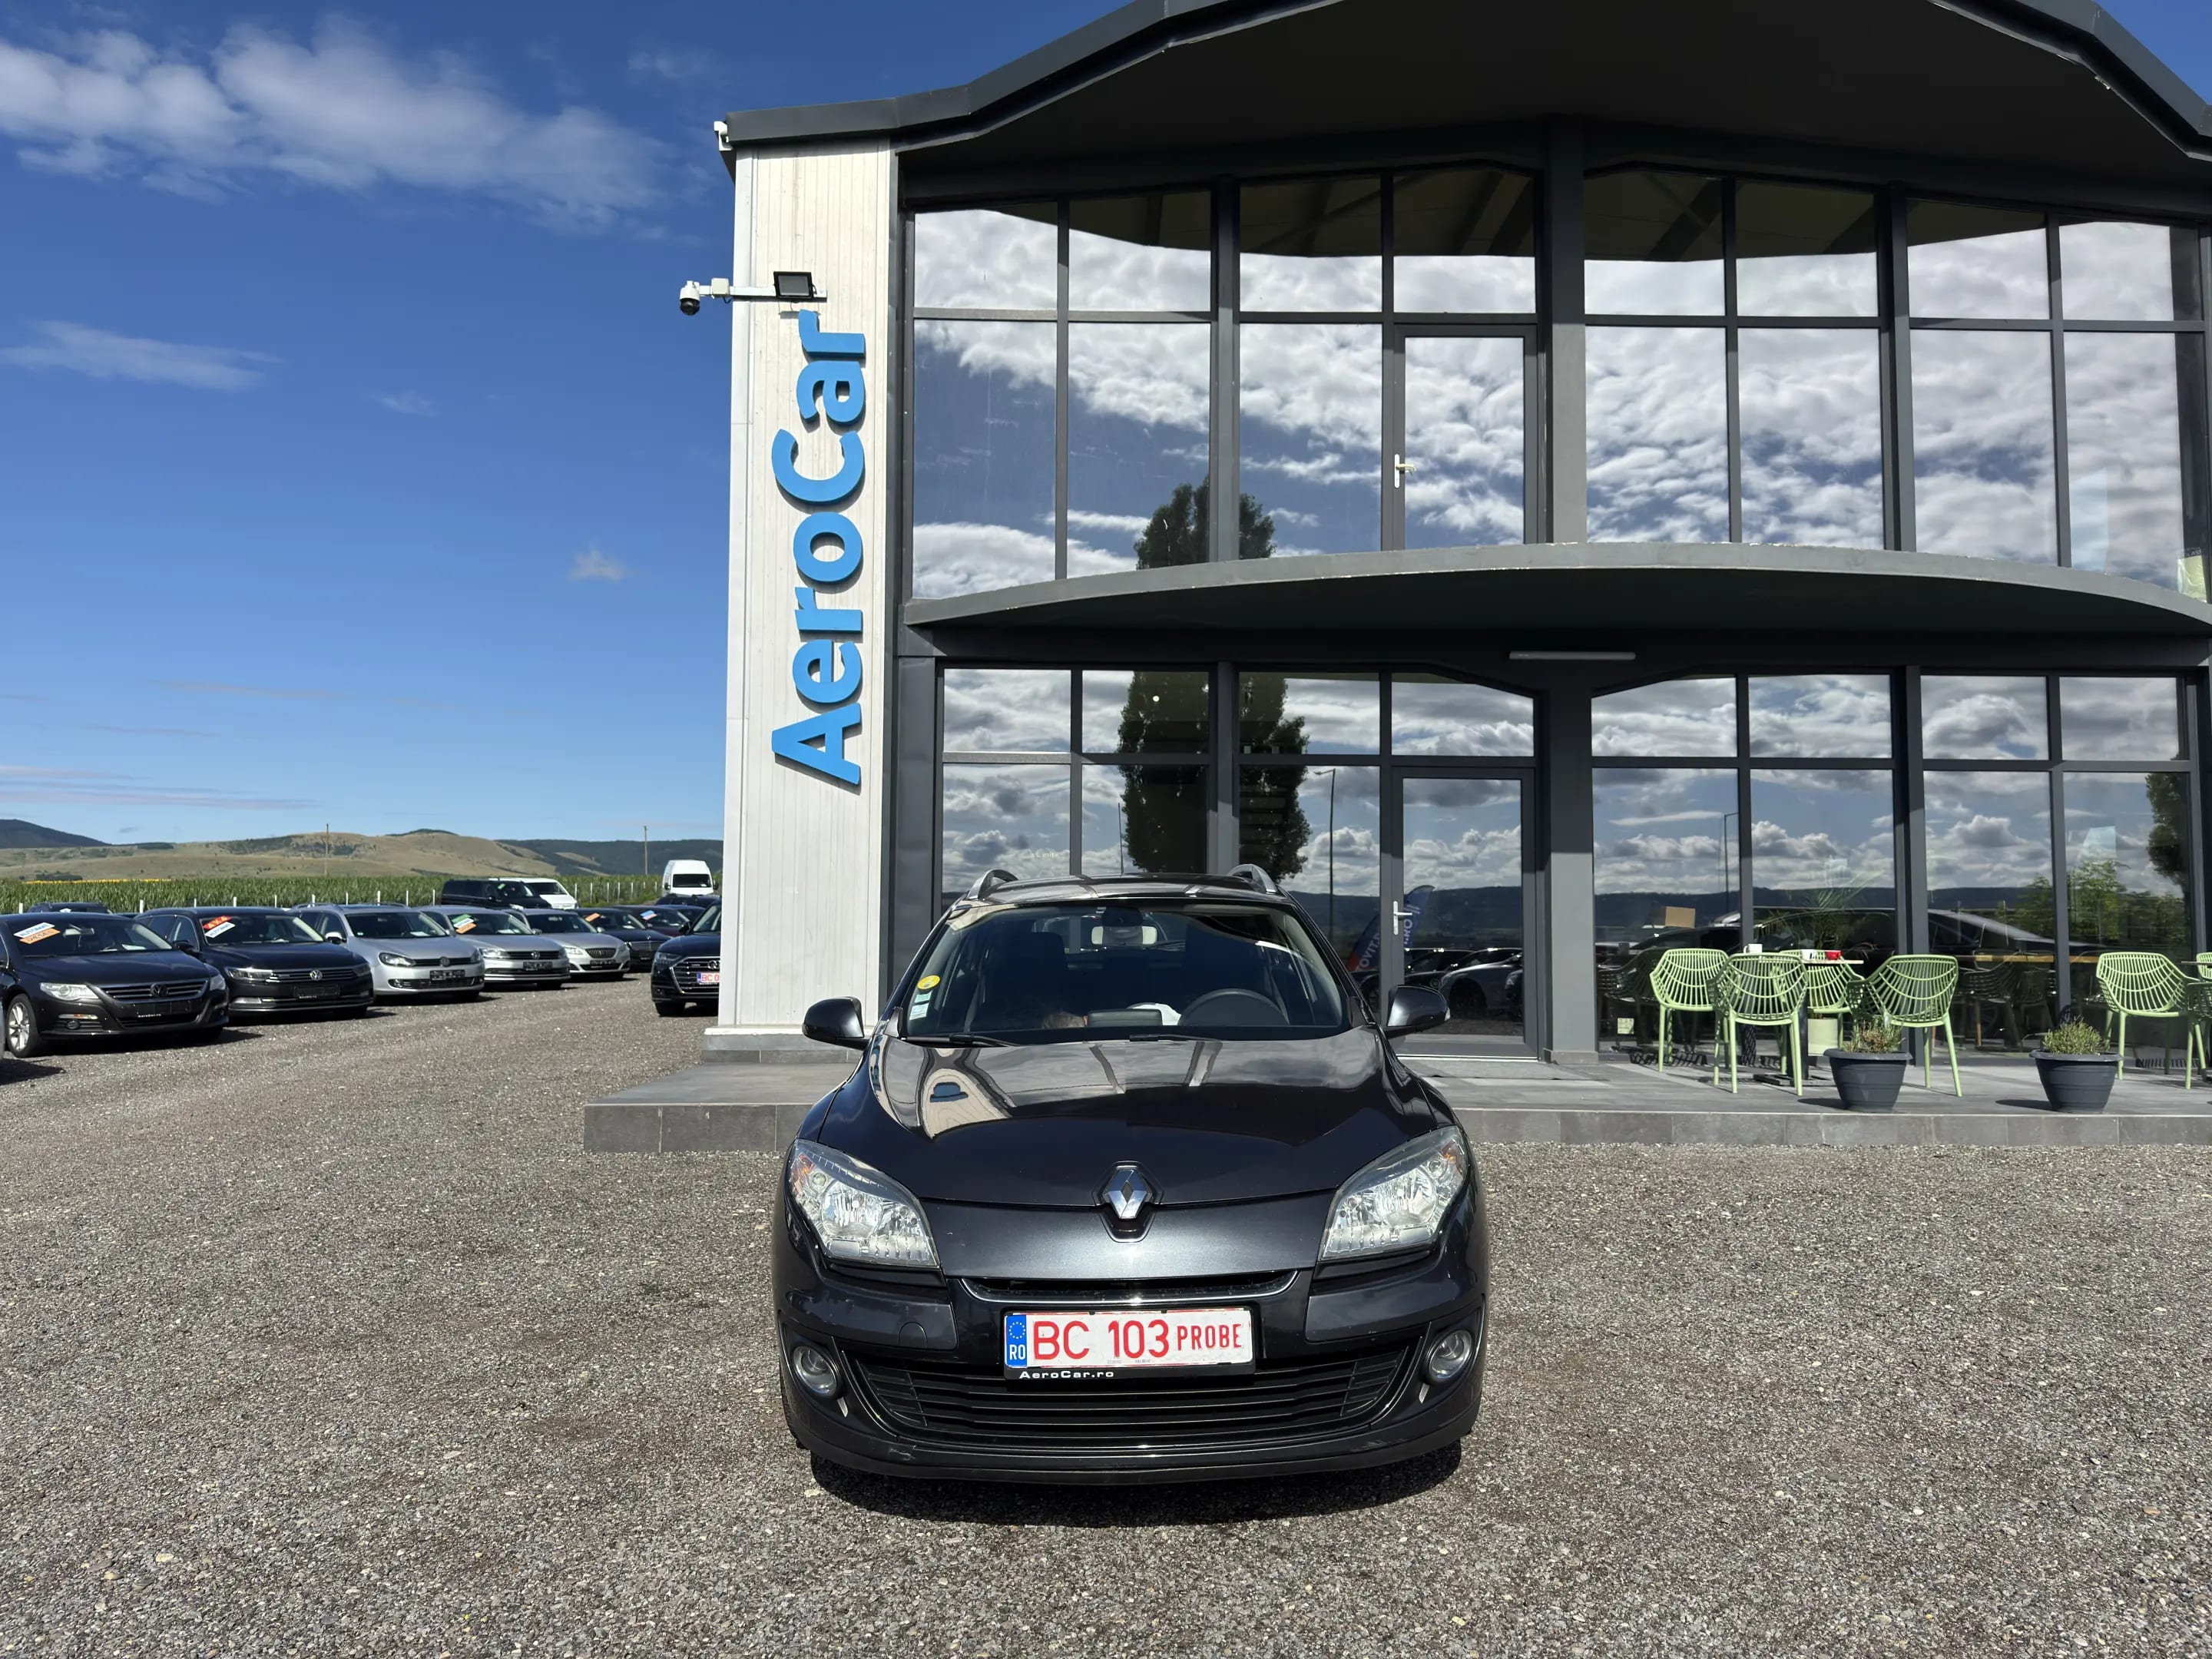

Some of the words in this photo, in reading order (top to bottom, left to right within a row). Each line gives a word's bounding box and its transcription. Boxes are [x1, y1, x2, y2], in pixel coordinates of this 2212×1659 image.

[771, 309, 866, 786] AeroCar
[1010, 1344, 1026, 1361] RO
[1034, 1320, 1090, 1360] BC
[1108, 1320, 1170, 1359] 103
[1177, 1323, 1242, 1351] PROBE
[1019, 1370, 1114, 1379] AeroCar.ro
